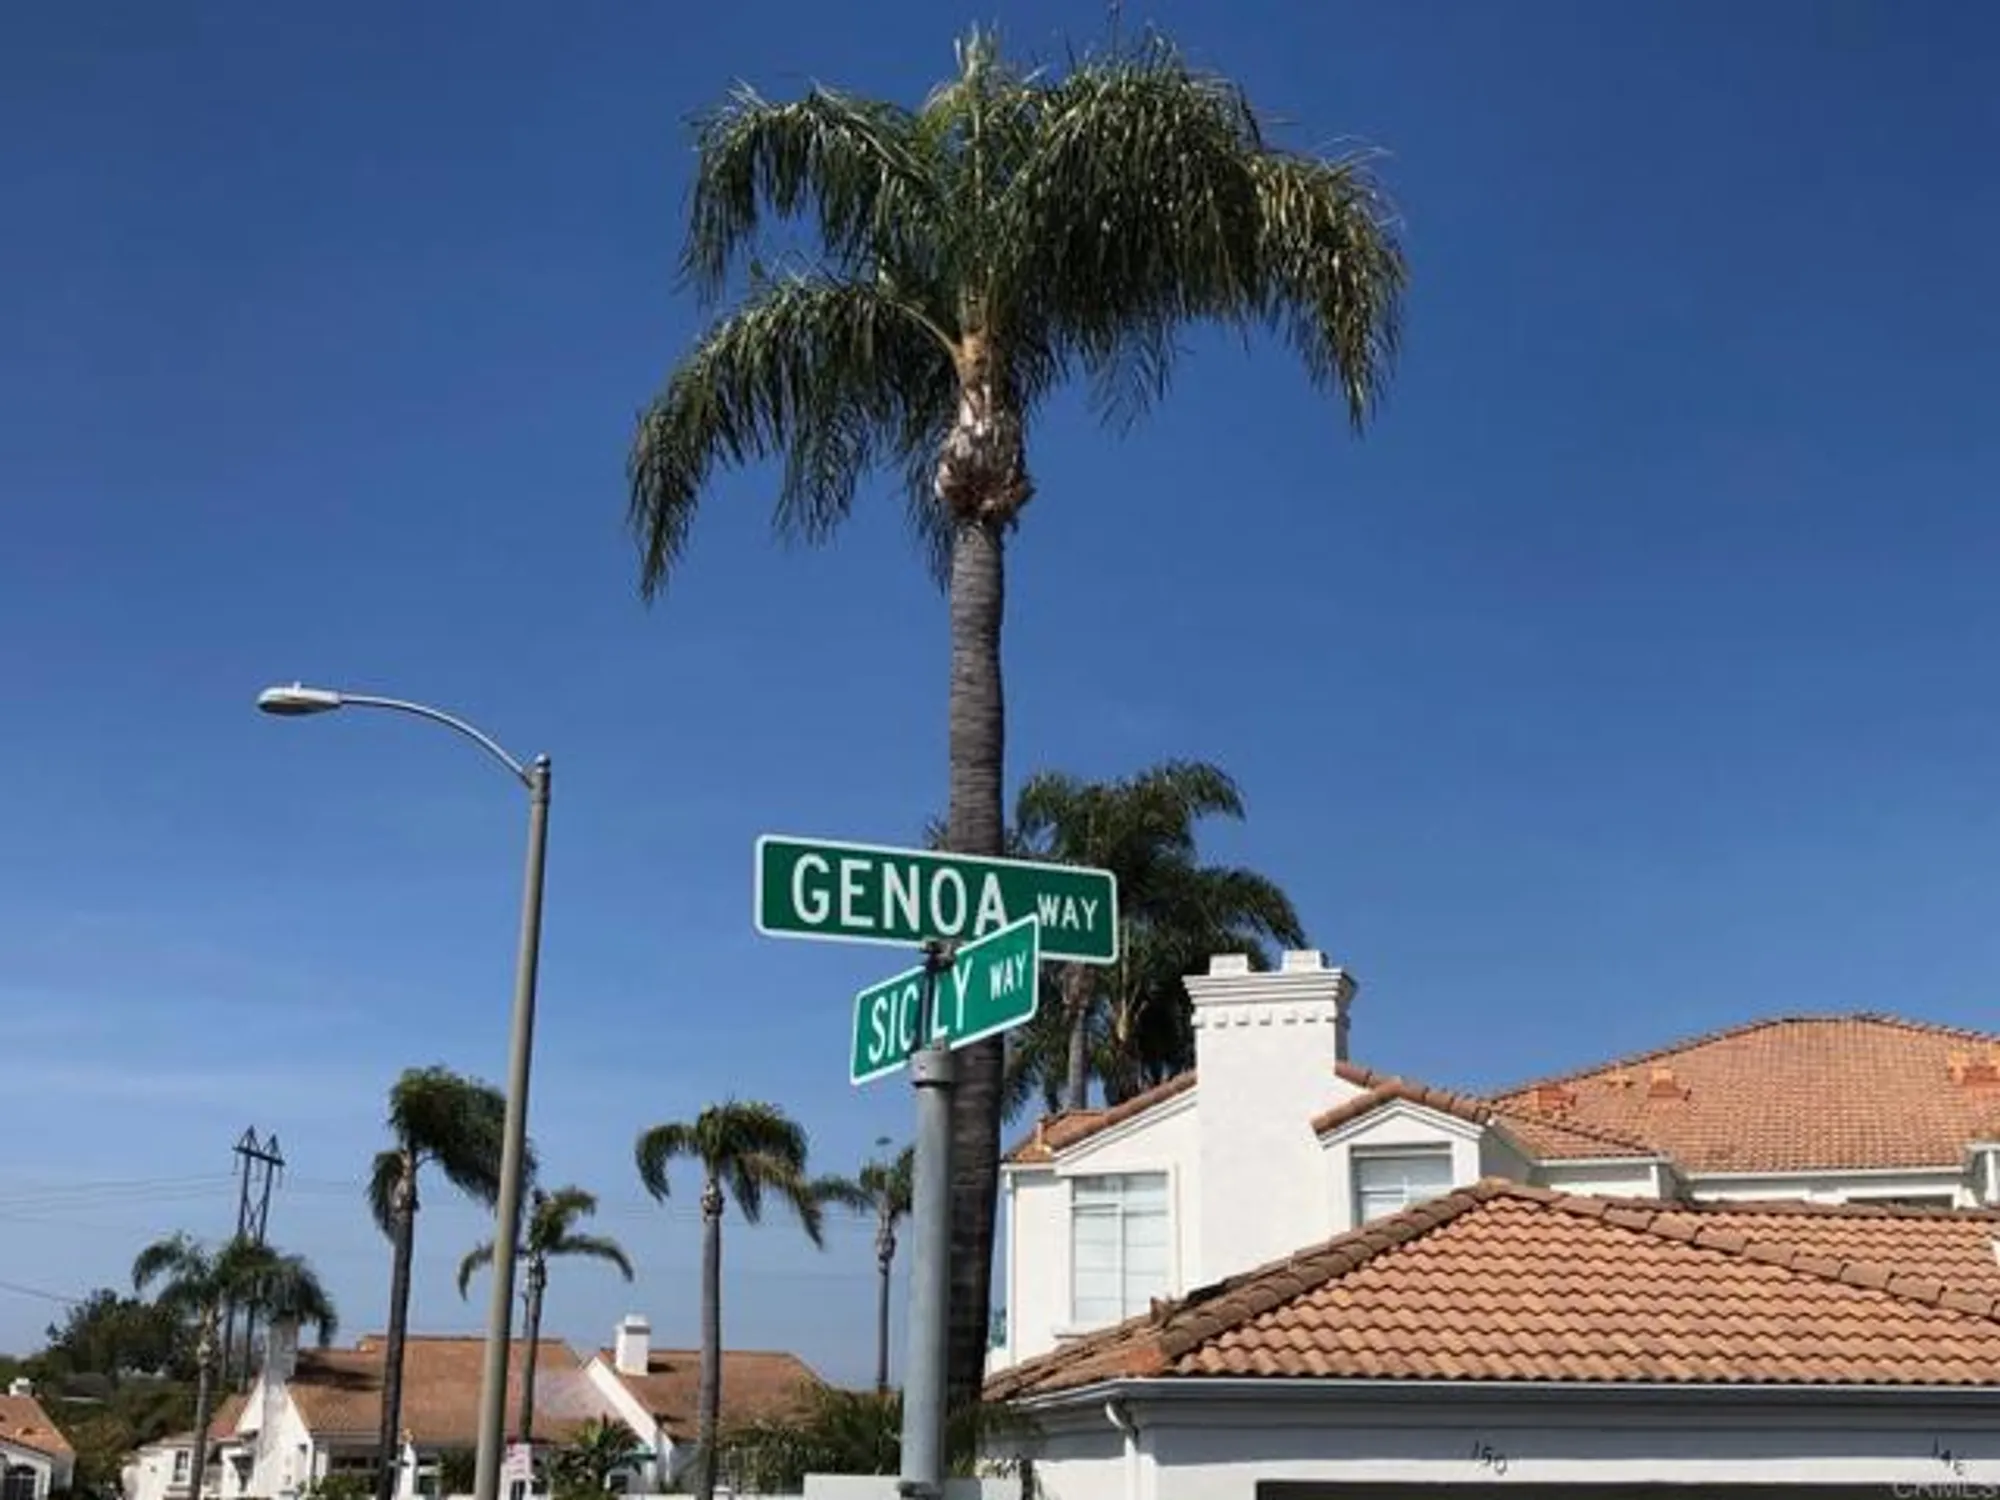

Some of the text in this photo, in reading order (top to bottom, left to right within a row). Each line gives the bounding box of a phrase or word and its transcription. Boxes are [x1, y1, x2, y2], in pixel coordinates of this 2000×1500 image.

[792, 853, 1098, 936] GENOA WAY
[868, 950, 1026, 1064] SICLY WAY
